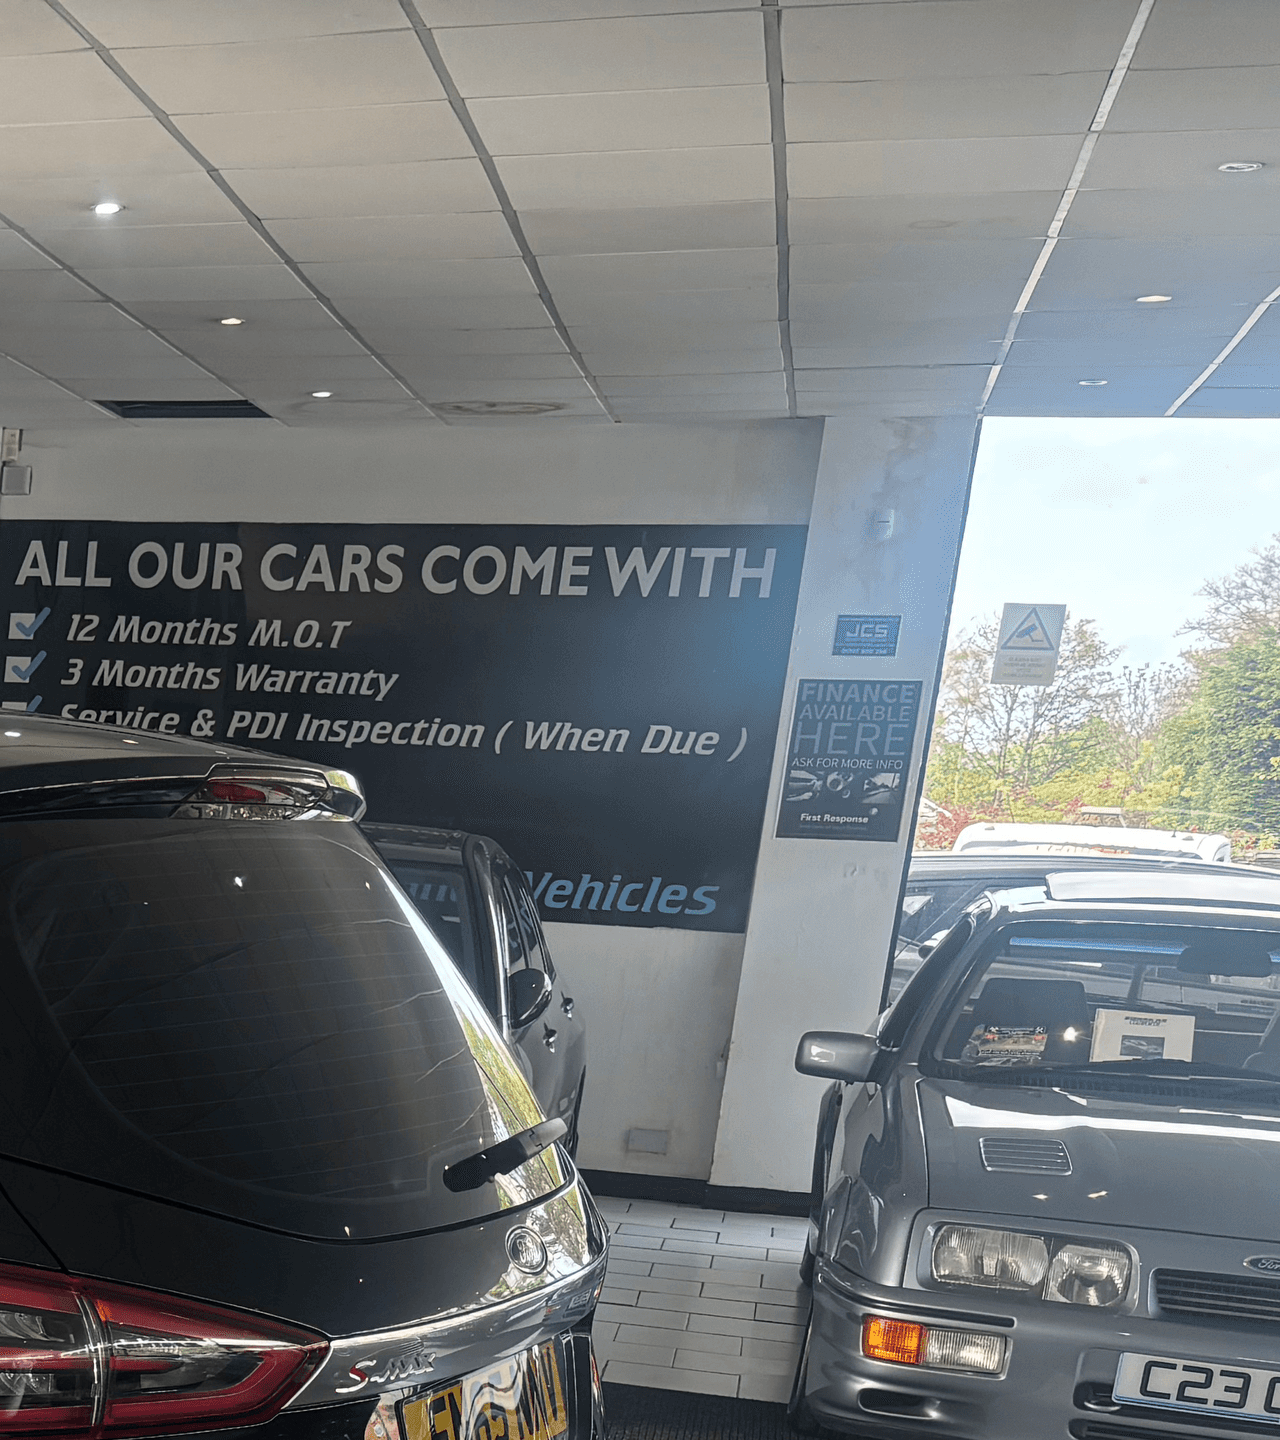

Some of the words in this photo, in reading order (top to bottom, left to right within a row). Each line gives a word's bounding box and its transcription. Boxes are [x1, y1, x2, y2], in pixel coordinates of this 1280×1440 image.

[14, 539, 112, 588] ALL
[128, 541, 243, 590] OUR
[260, 543, 405, 593] CARS
[421, 544, 594, 596] COME
[604, 546, 778, 598] WITH
[66, 614, 101, 642] 12
[108, 615, 238, 646] Months
[248, 618, 353, 649] M.O.T
[846, 624, 888, 638] JCS
[60, 657, 84, 686] 3
[92, 658, 222, 691] Months
[236, 662, 400, 702] Warranty
[801, 682, 917, 704] FINANCE
[799, 703, 913, 722] AVAILABLE
[190, 707, 216, 737] &
[226, 709, 288, 740] PDI
[295, 713, 485, 749] Inspection
[525, 720, 630, 753] When
[640, 724, 720, 756] Due
[793, 721, 910, 756] HERE
[791, 757, 814, 767] ASK
[816, 757, 840, 768] FOR
[841, 758, 873, 769] MORE
[876, 759, 903, 770] INFO
[800, 812, 821, 822] First
[823, 813, 869, 824] Response
[523, 870, 720, 916] Vehicles
[1140, 1360, 1252, 1409] C23
